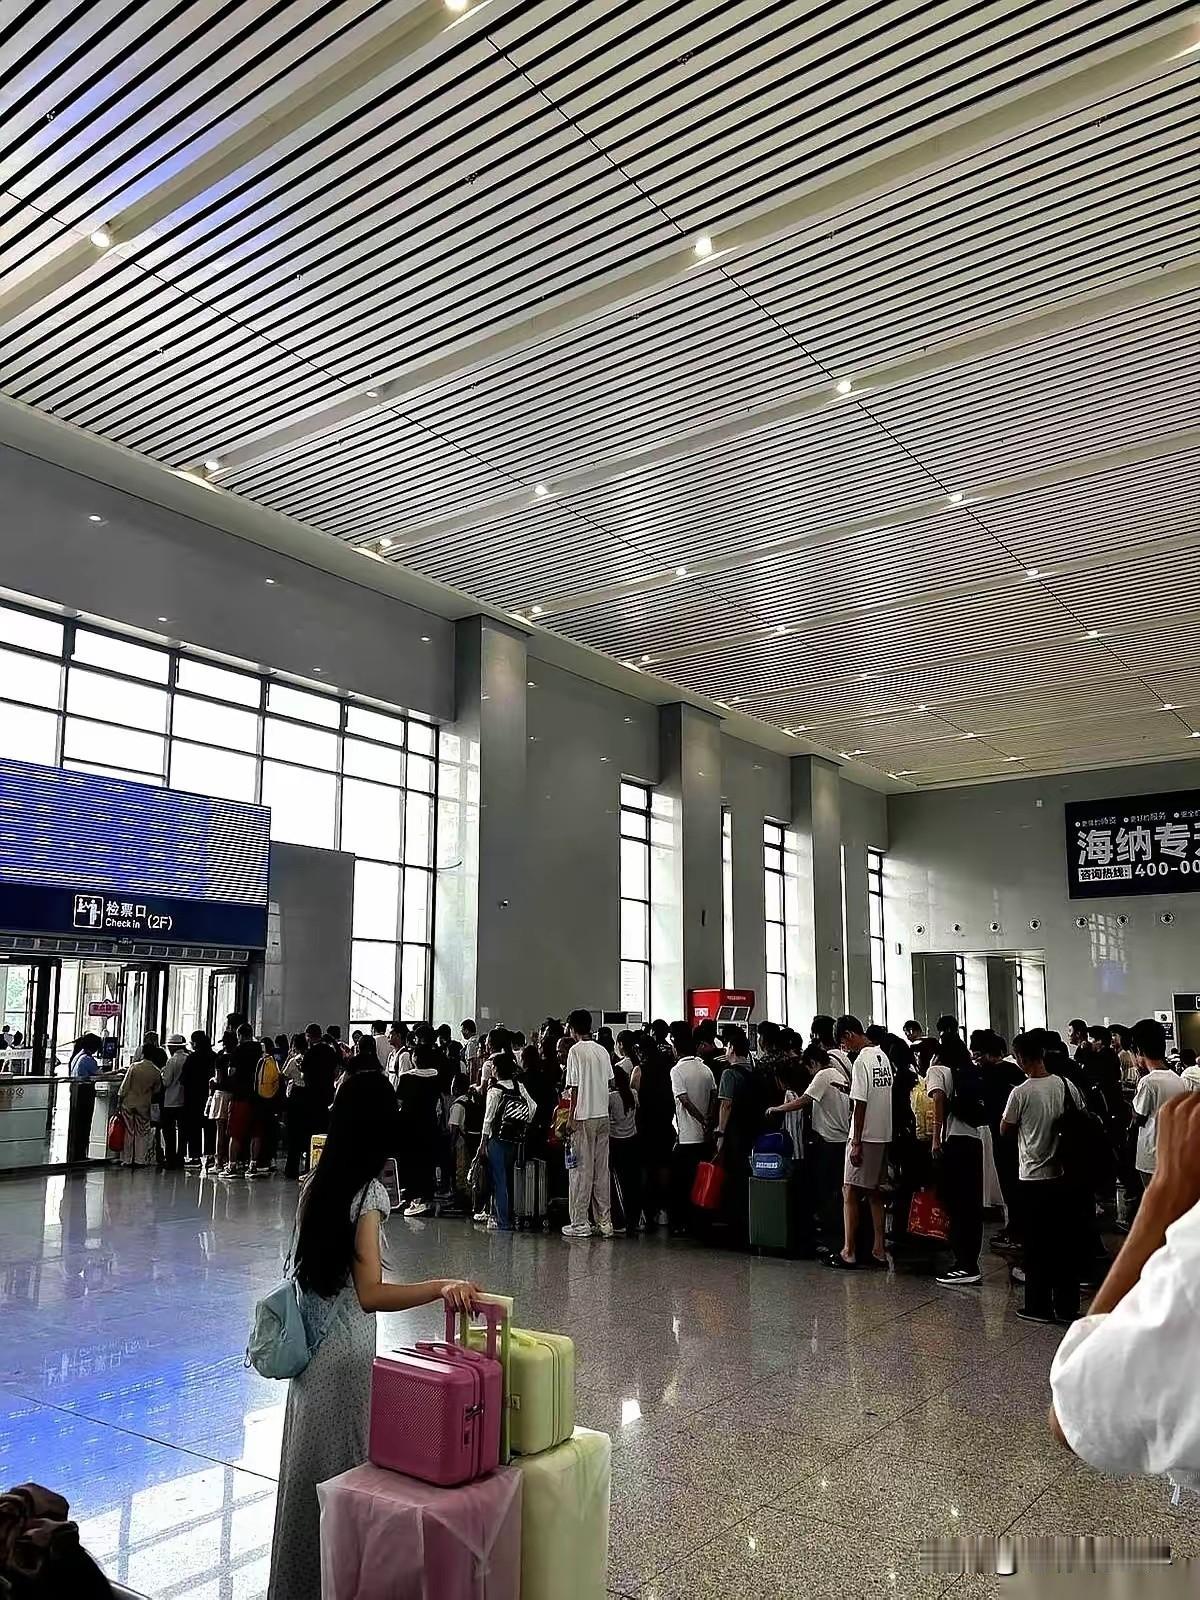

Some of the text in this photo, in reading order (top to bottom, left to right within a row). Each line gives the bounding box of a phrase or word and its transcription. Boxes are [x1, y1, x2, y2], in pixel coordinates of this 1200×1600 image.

[1077, 822, 1200, 865] 海纳专
[106, 901, 147, 918] 检票口
[105, 917, 131, 928] Check
[148, 915, 172, 930] (2F)
